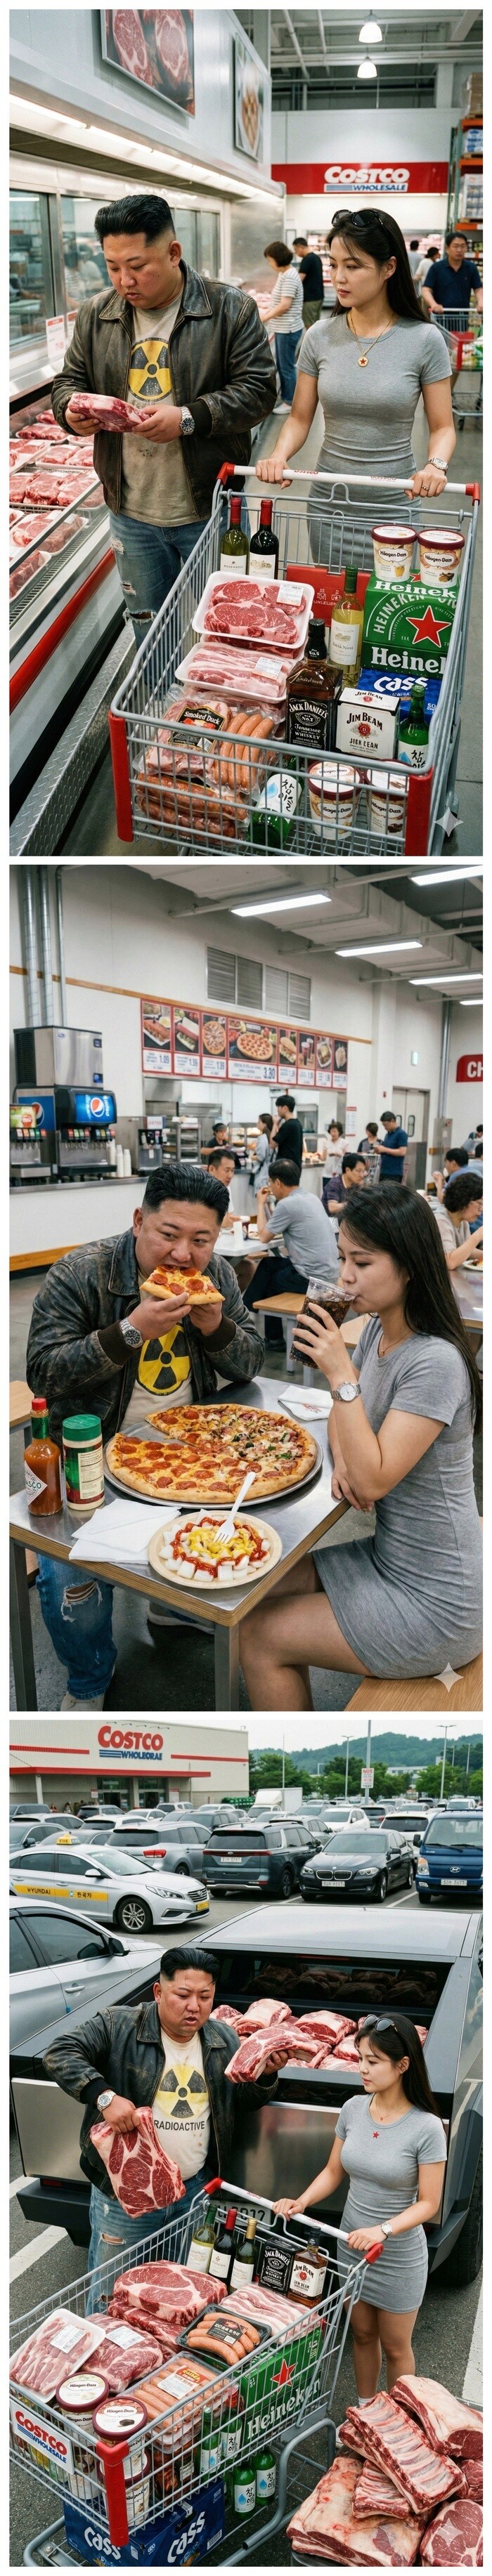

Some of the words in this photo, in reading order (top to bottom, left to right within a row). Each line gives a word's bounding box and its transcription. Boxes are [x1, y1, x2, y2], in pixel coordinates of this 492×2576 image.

[324, 166, 410, 183] COSTCO
[374, 580, 457, 599] Heinek
[184, 711, 207, 720] Smoked
[206, 714, 221, 725] Duck
[289, 703, 304, 713] JACK
[304, 701, 329, 719] DANIEL'S
[347, 712, 361, 724] JIM
[362, 712, 383, 731] BEAM
[97, 1725, 164, 1751] COSTCO
[154, 2119, 205, 2131] RADIOACTIVE
[302, 2264, 314, 2278] BEAM
[15, 2410, 67, 2457] COSTCO
[31, 2434, 67, 2464] WHOLESALE
[167, 2511, 206, 2563] Cass
